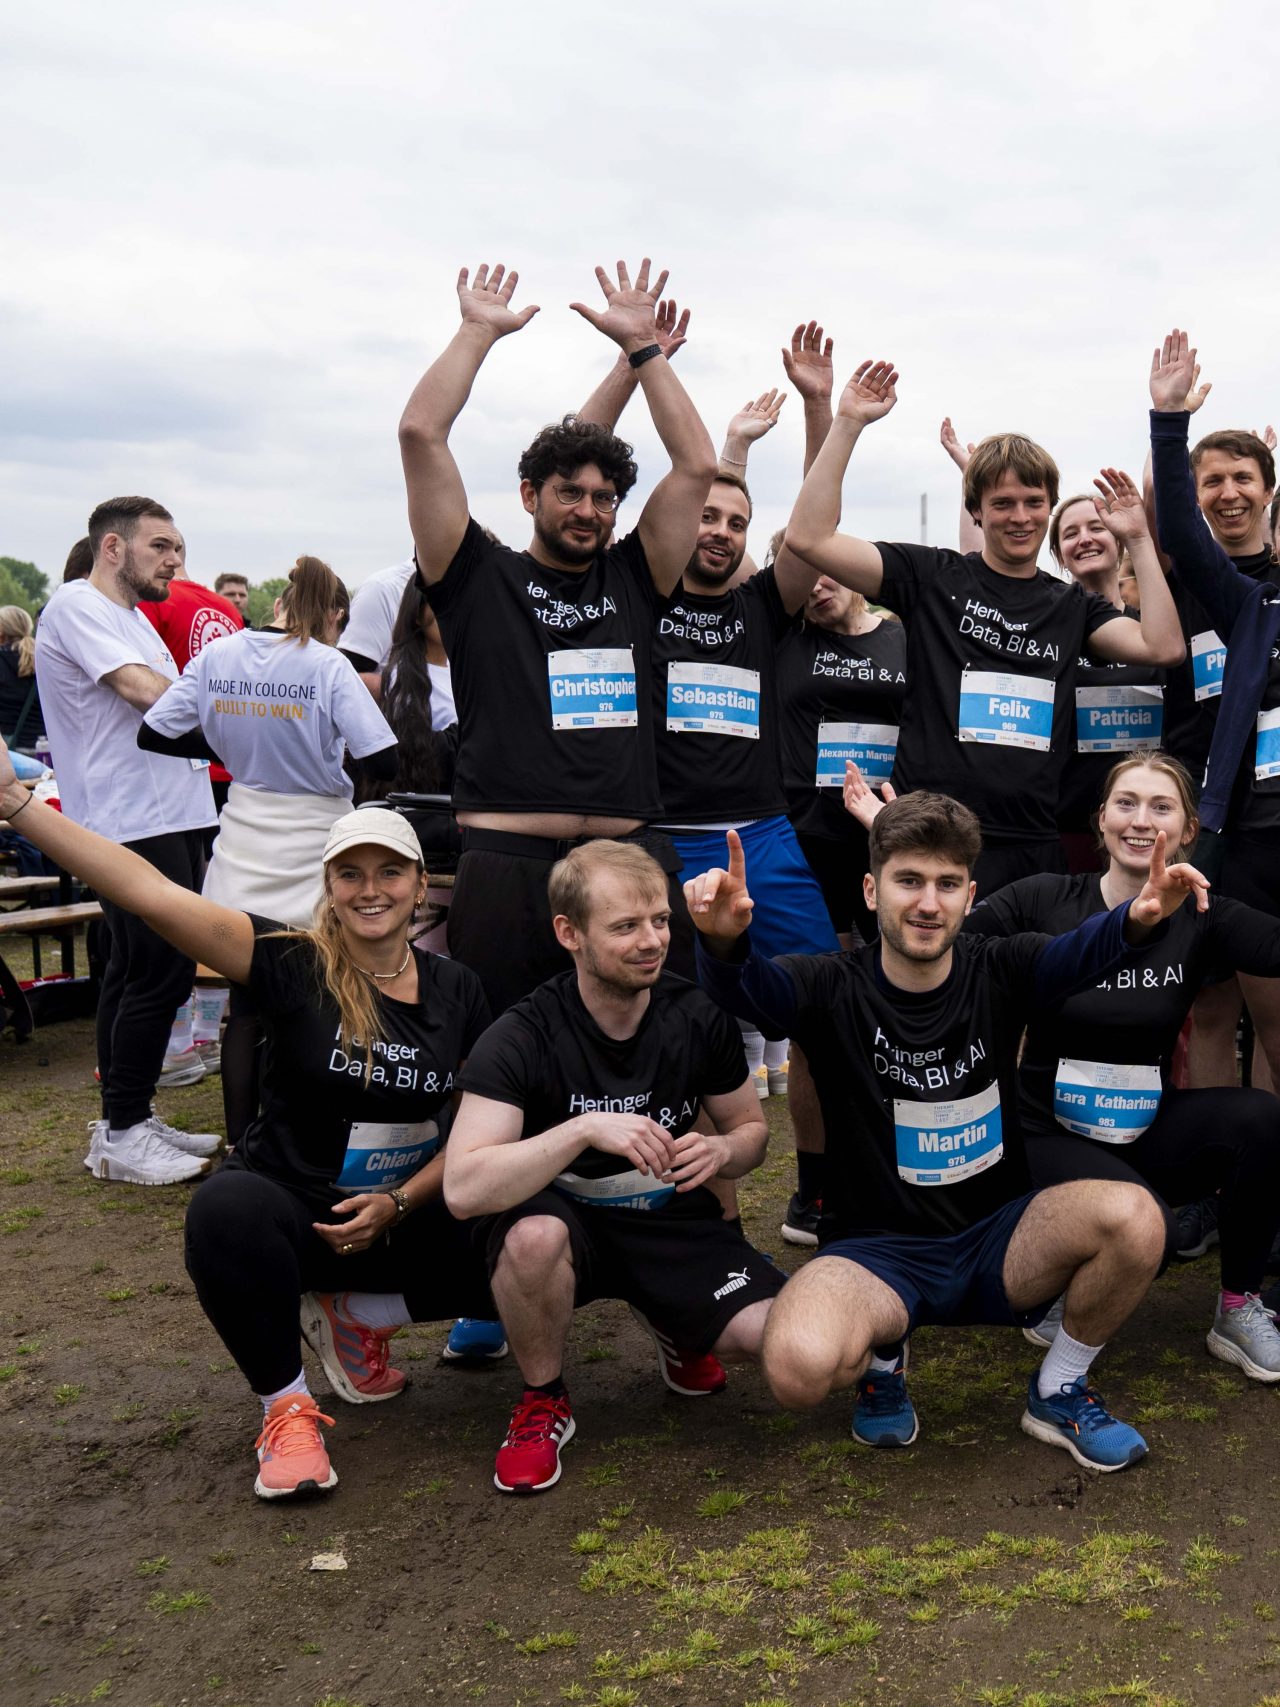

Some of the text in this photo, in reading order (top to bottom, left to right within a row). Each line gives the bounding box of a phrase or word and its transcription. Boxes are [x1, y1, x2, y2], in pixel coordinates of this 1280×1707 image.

[584, 604, 601, 620] &
[660, 618, 704, 645] Data,
[705, 630, 723, 645] BI
[724, 625, 735, 643] &
[959, 615, 1059, 662] Data, BI & AI
[813, 661, 855, 680] Data,
[858, 668, 874, 681] BI
[879, 668, 892, 682] &
[208, 679, 236, 695] MADE
[238, 681, 252, 696] IN
[215, 699, 248, 715] BUILT
[250, 702, 266, 718] TO
[599, 702, 614, 711] 976
[671, 686, 756, 712] Sebastian
[988, 697, 1031, 720] Felix
[1002, 722, 1018, 732] 969
[1090, 709, 1152, 727] Patricia
[819, 748, 864, 759] Alexandra
[859, 767, 868, 776] 84
[1117, 968, 1136, 989] BI
[1142, 967, 1158, 988] &
[1163, 963, 1183, 987] AI
[925, 1065, 950, 1089] BI
[953, 1059, 969, 1080] &
[970, 1038, 986, 1069] AI
[396, 1066, 418, 1090] BI
[424, 1071, 439, 1092] &
[569, 1091, 652, 1114] Heringer
[1056, 1088, 1158, 1110] Lara Katharina
[659, 1097, 697, 1129] & AI
[1098, 1117, 1115, 1128] 983
[918, 1123, 987, 1153] Martin
[366, 1150, 422, 1172] Chiara
[948, 1155, 966, 1167] 978
[713, 1277, 747, 1301] PUMA
